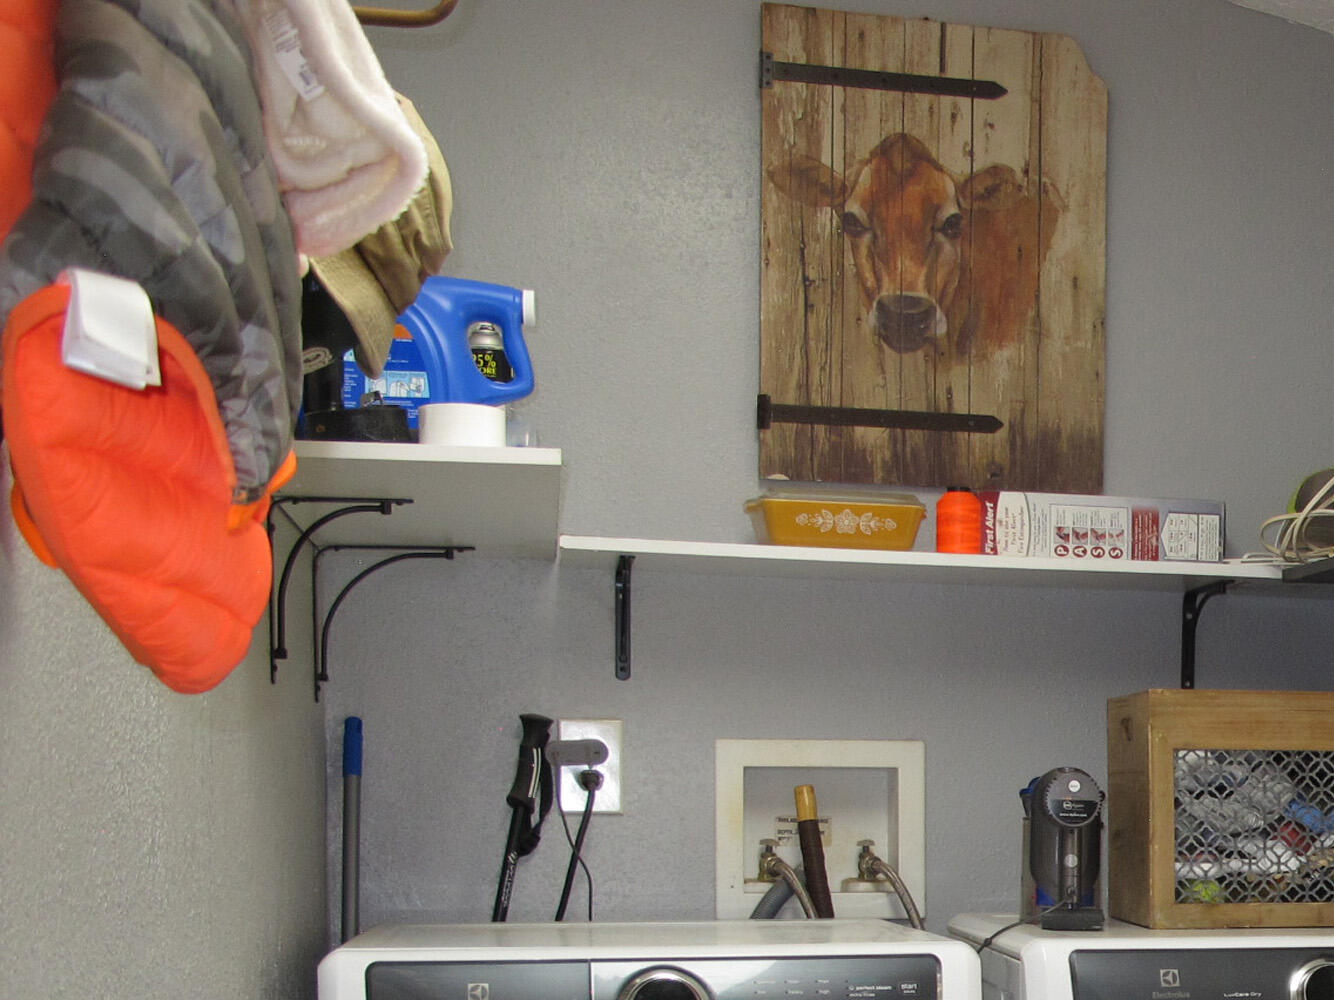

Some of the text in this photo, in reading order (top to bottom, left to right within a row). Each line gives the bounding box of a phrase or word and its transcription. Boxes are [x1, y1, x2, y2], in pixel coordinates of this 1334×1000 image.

[985, 500, 995, 554] First Alert
[1152, 991, 1190, 999] Electrolux
